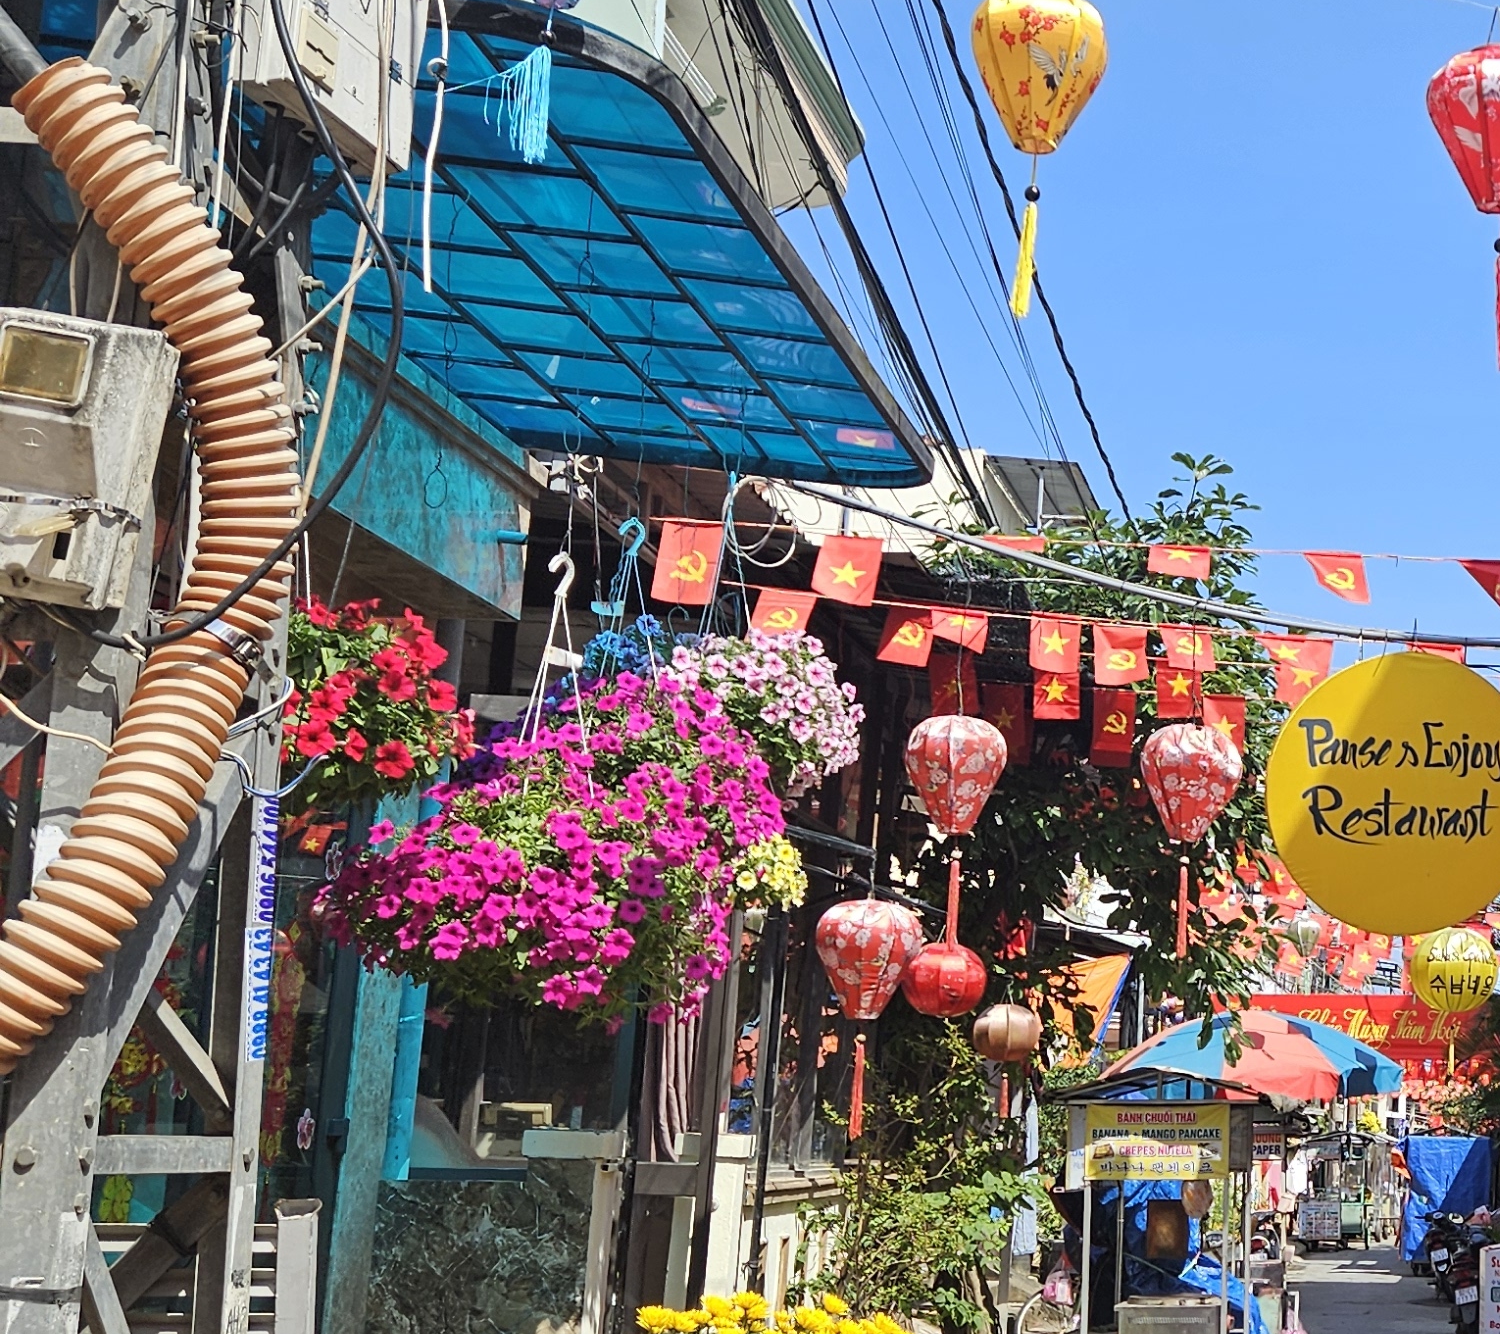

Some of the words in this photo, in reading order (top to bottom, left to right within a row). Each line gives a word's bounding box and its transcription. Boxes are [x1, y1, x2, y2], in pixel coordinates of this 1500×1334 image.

[1298, 719, 1393, 770] Pause
[1302, 785, 1500, 845] Restaurant
[1092, 1129, 1130, 1139] BANANA
[1141, 1129, 1176, 1139] MANGO
[1178, 1129, 1221, 1139] PANCAKE
[1119, 1145, 1155, 1156] CREPES
[1157, 1145, 1193, 1156] NUTELA
[1253, 1145, 1281, 1155] PAPER
